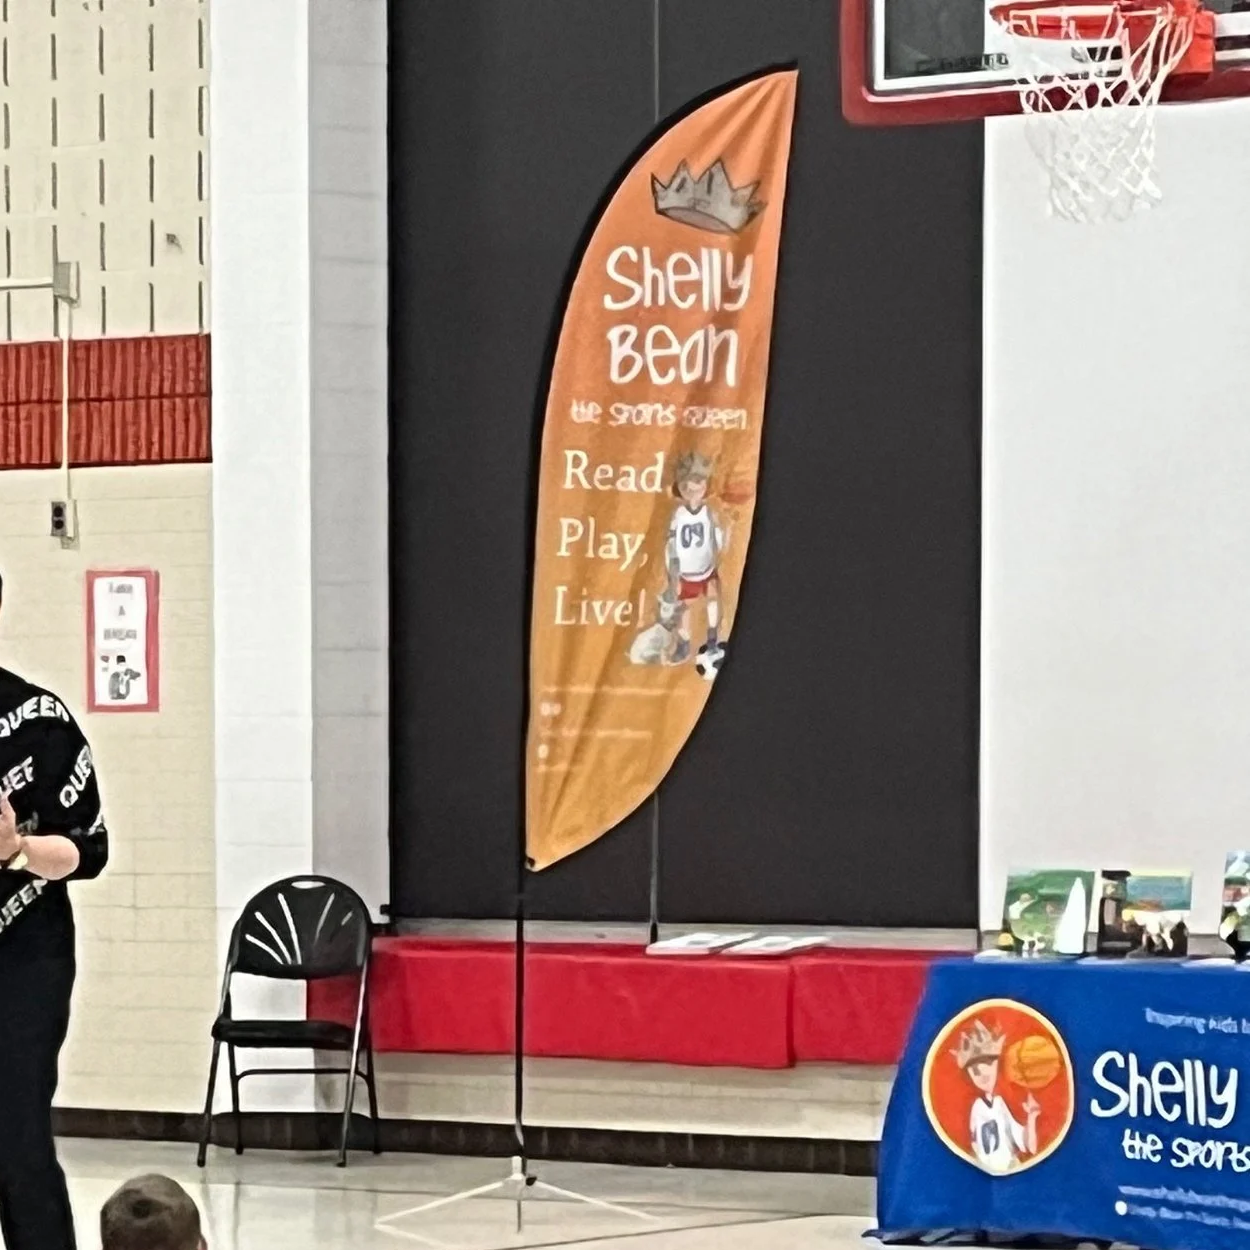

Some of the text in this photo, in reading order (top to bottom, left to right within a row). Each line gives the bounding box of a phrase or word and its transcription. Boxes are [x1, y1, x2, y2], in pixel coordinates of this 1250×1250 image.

[603, 245, 754, 312] Shelly
[606, 323, 739, 388] Bean
[556, 516, 649, 572] Play,
[1090, 1050, 1239, 1129] Shelly
[1122, 1128, 1164, 1163] the
